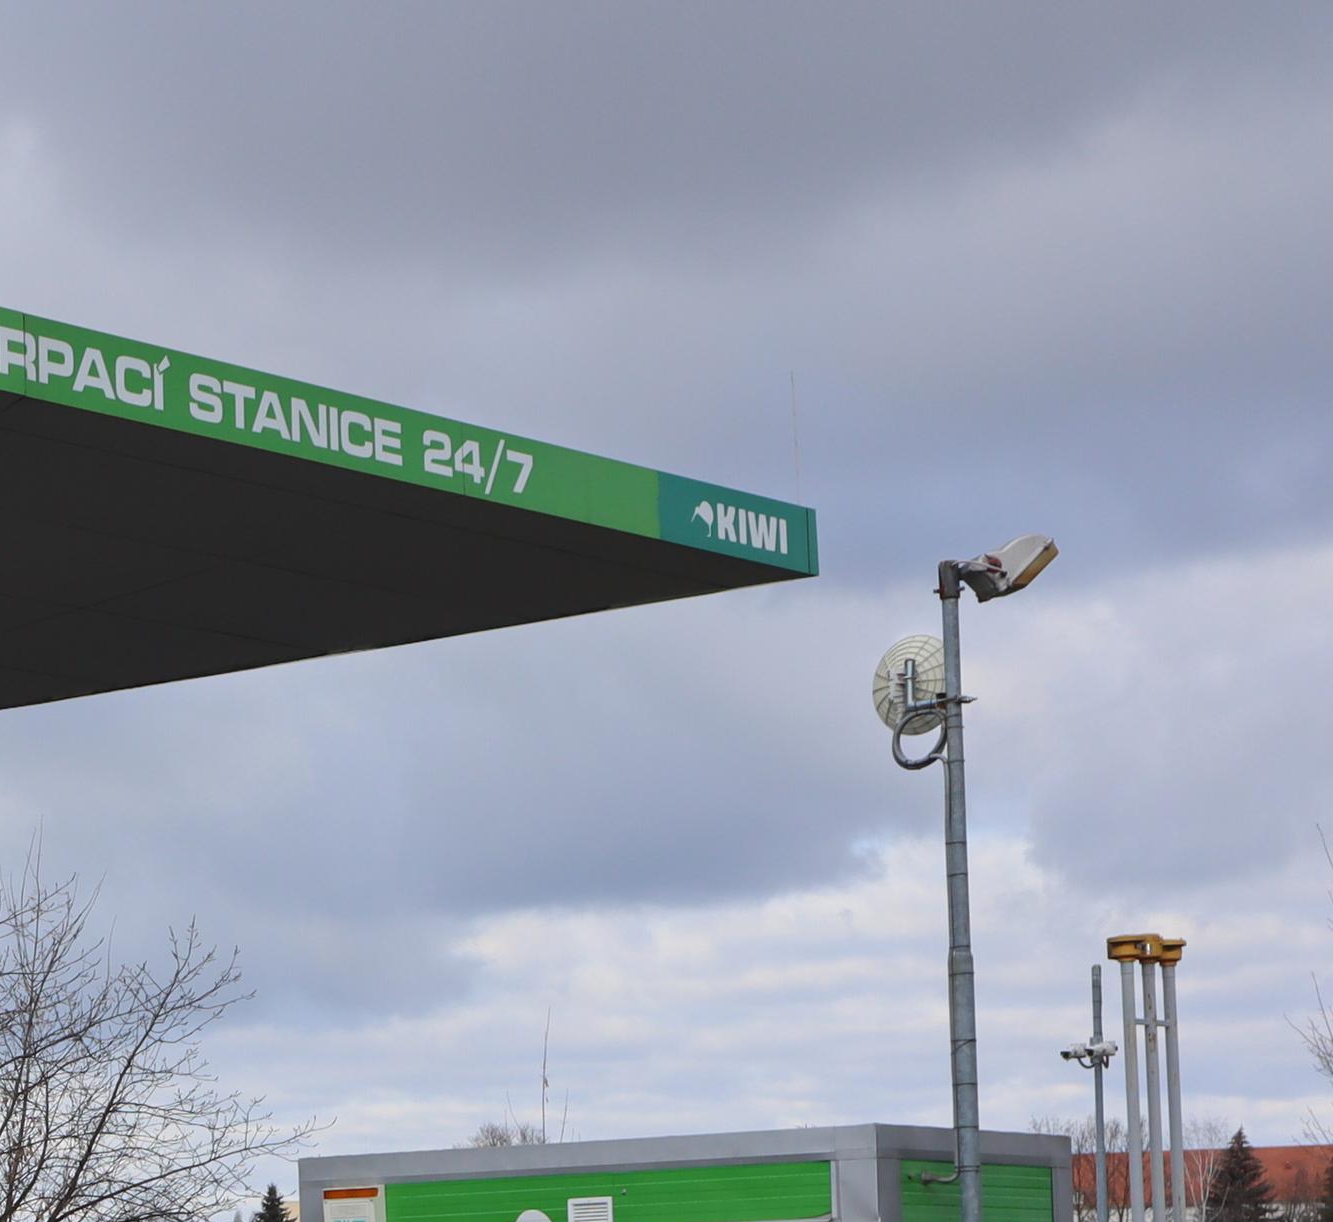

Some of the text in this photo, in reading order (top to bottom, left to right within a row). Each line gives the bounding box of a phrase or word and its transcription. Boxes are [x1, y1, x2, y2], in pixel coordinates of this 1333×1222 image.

[189, 373, 403, 466] STANICE
[423, 429, 534, 495] 24/7
[716, 503, 788, 555] KIWI
